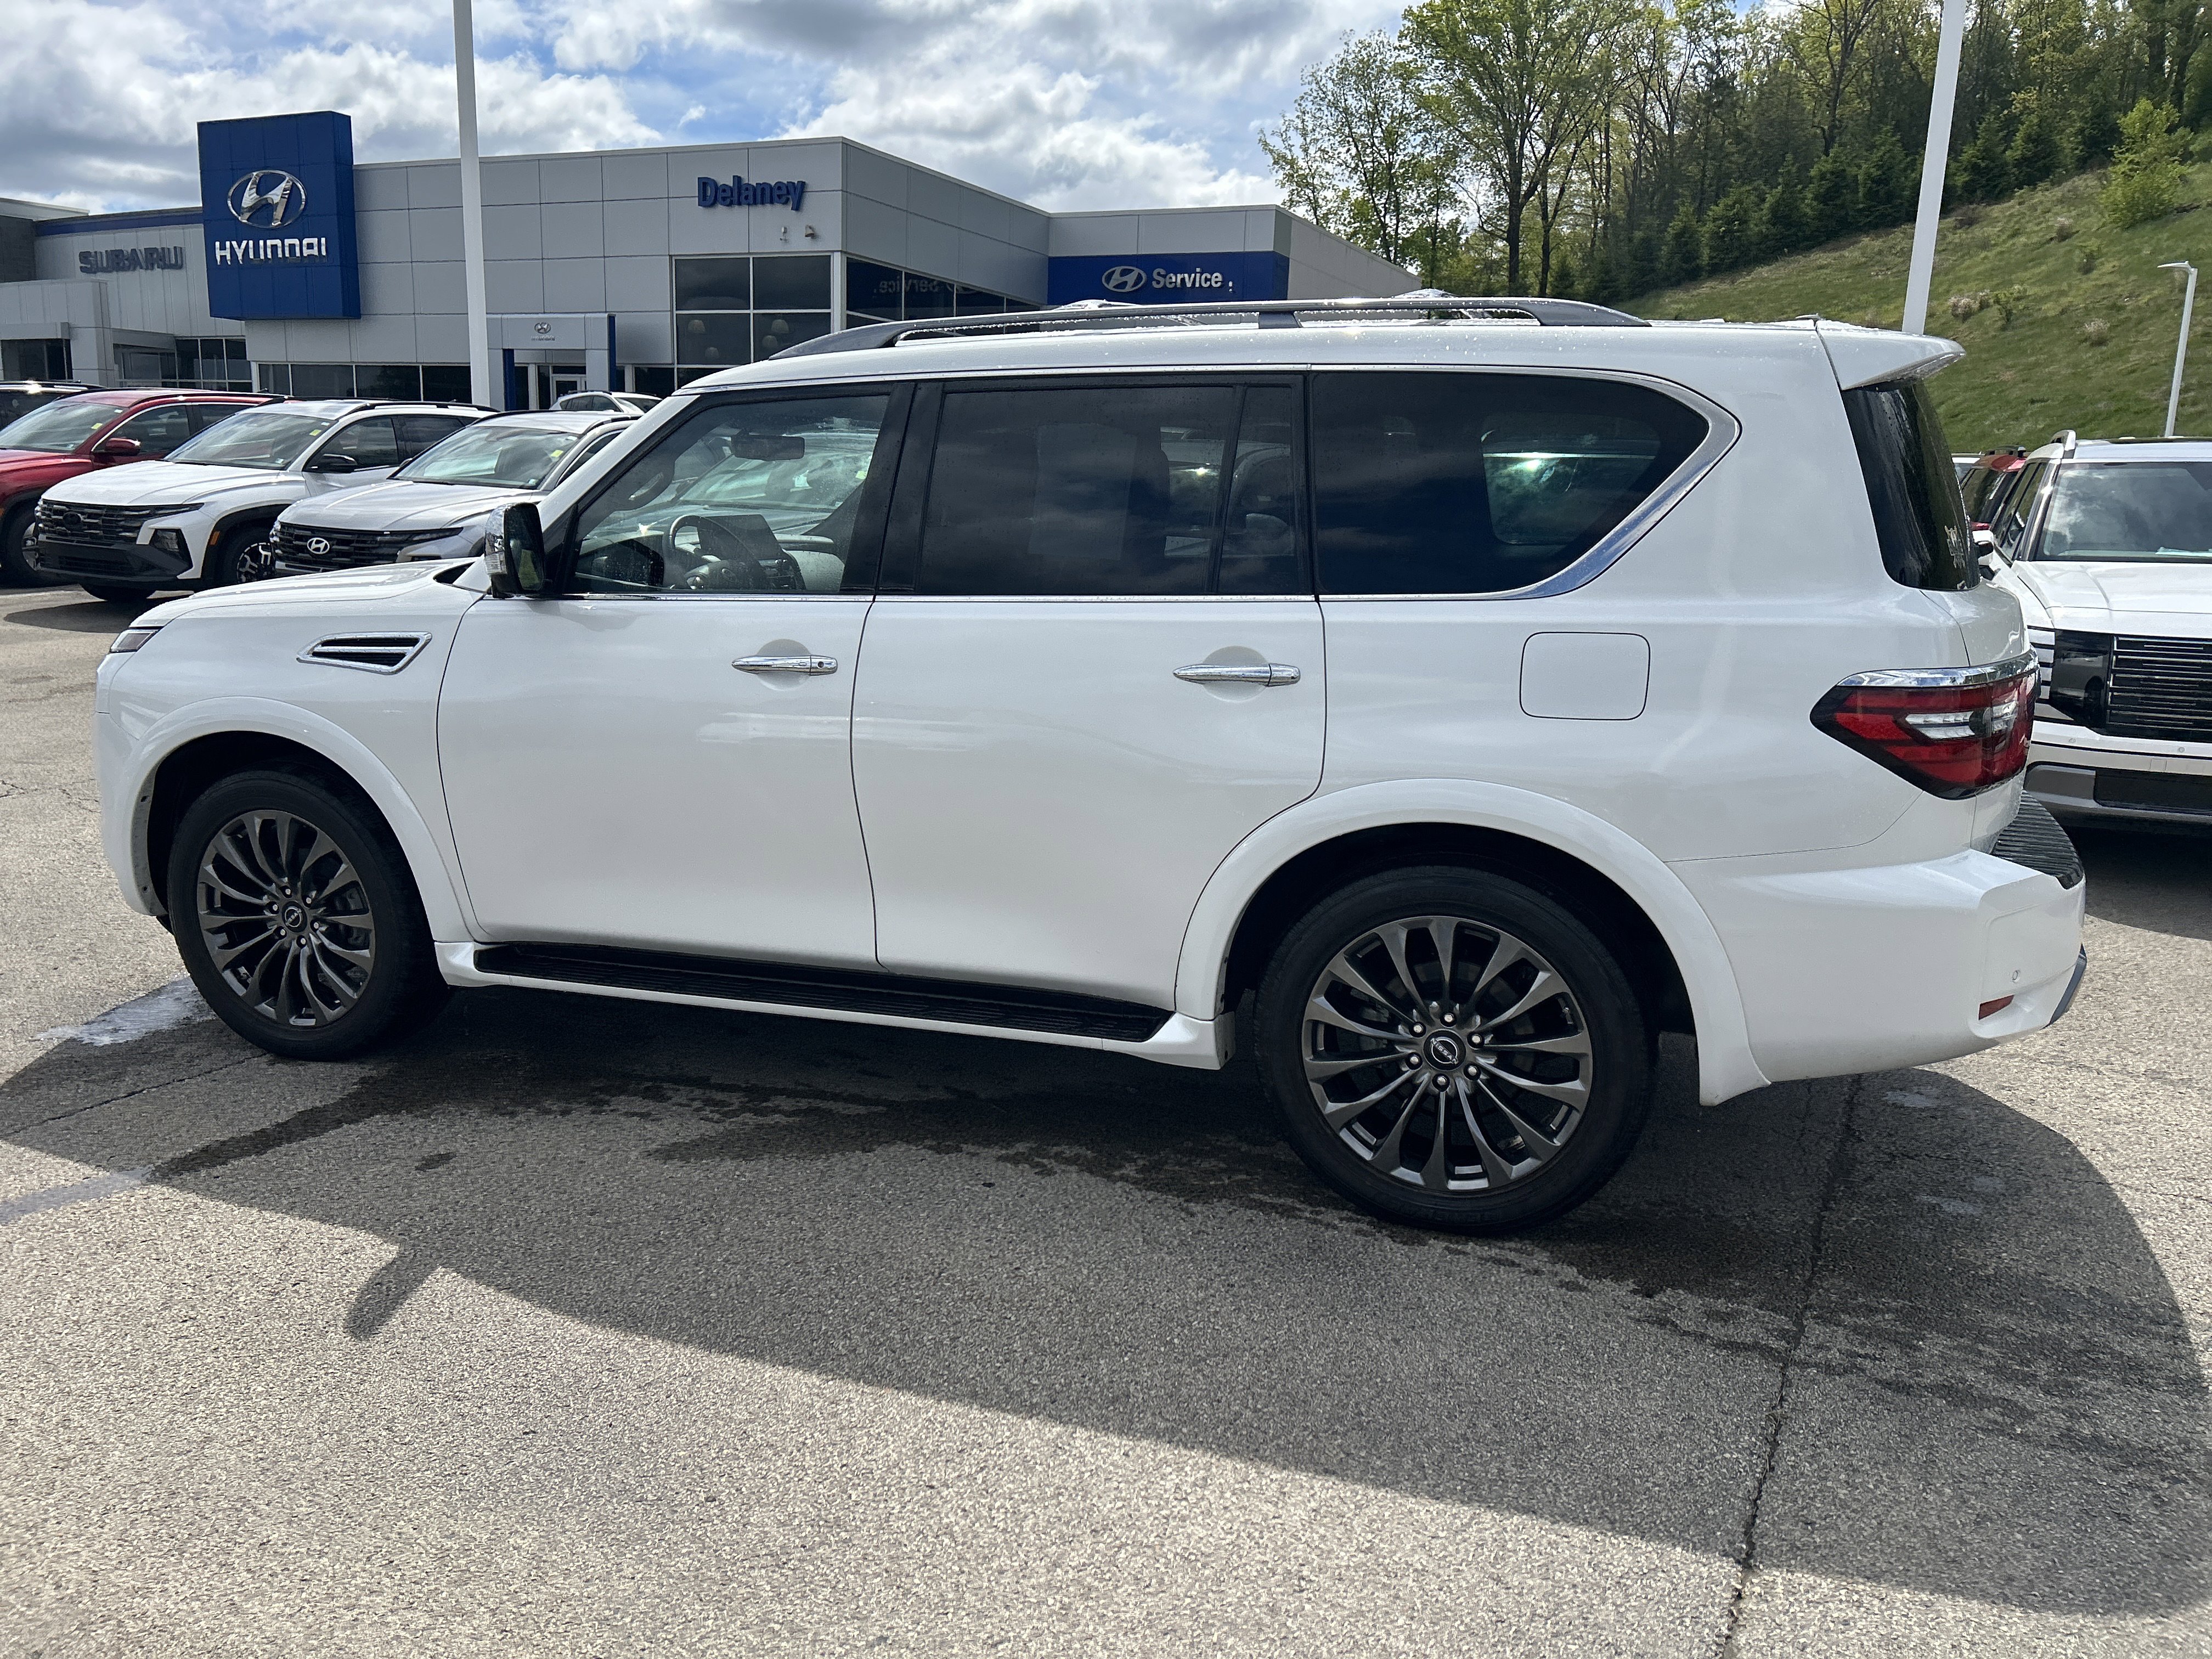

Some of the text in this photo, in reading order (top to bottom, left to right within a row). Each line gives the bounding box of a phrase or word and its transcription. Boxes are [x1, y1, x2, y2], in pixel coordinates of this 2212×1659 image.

[698, 175, 805, 211] Delaney
[79, 246, 184, 274] SUBARU
[215, 237, 326, 265] HYUNDAI
[1152, 268, 1223, 288] Service
[1430, 1037, 1458, 1065] NISSAN
